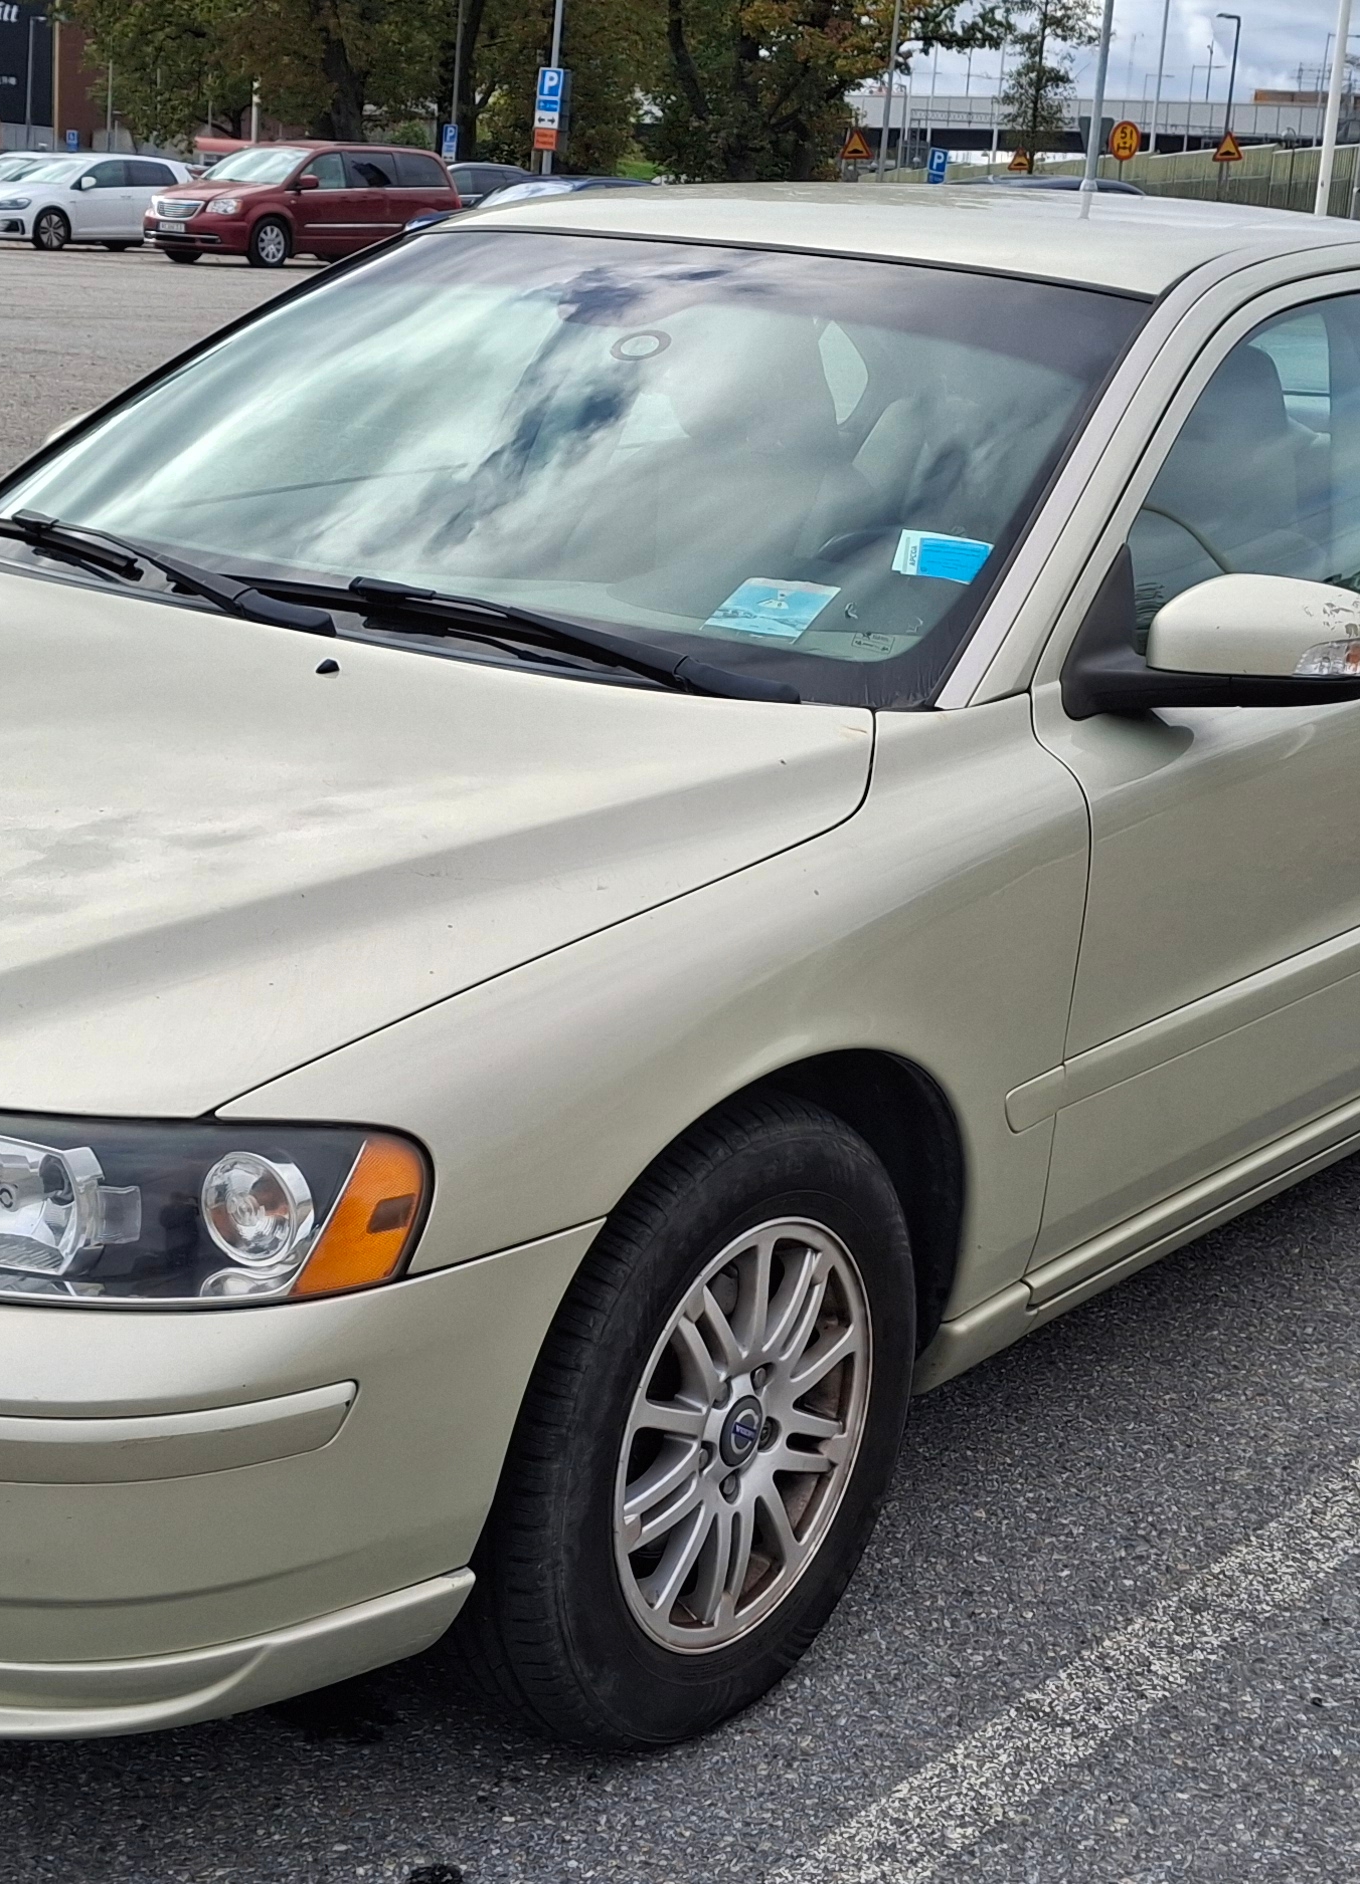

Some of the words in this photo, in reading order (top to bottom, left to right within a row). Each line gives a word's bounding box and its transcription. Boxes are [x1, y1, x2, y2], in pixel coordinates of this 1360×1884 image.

[543, 71, 559, 94] P
[446, 127, 455, 141] P
[932, 151, 945, 170] P
